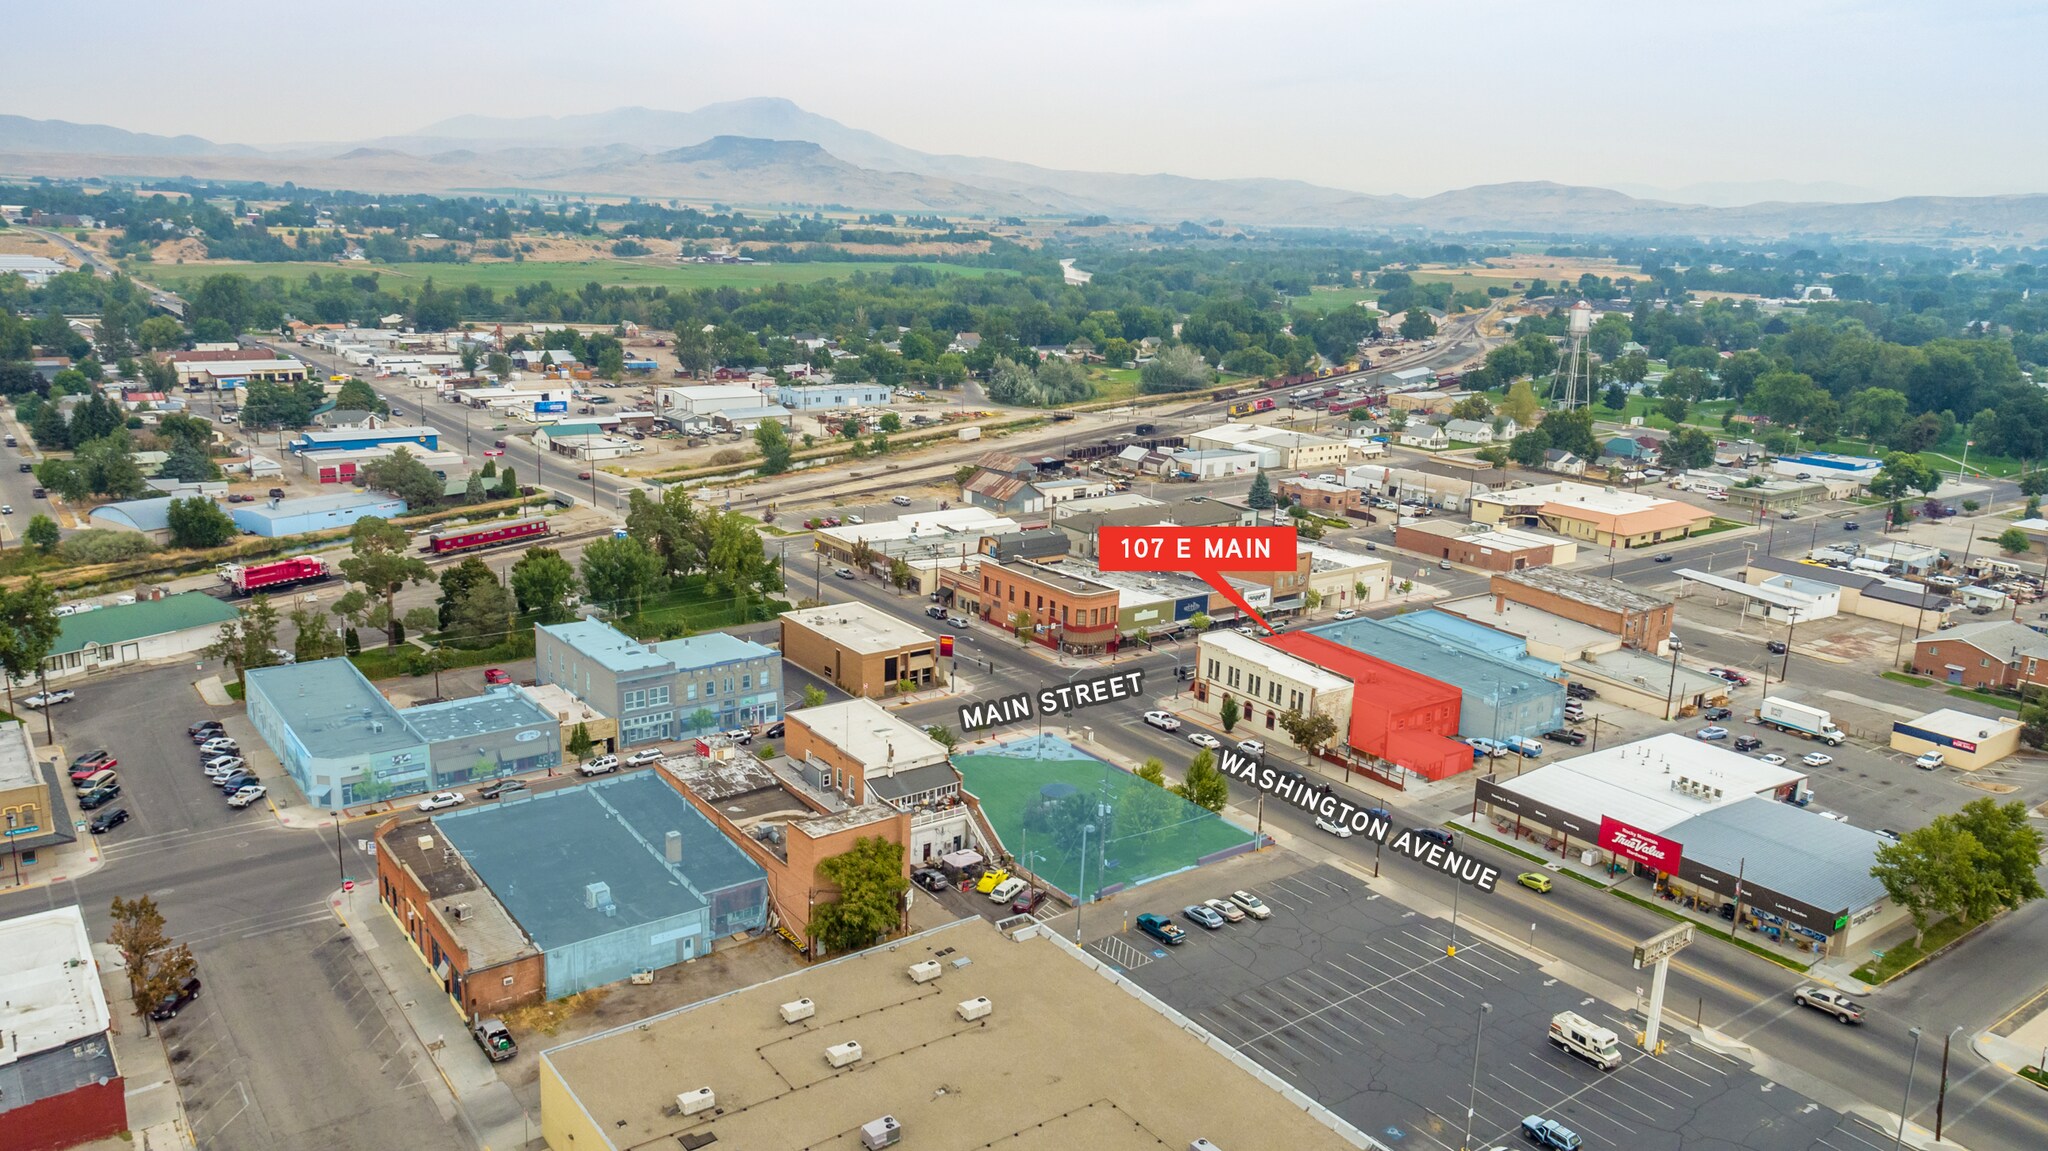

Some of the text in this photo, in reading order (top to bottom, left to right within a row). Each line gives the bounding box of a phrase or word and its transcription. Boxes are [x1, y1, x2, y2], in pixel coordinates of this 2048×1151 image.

[1622, 827, 1659, 846] Rocky Mountain
[1626, 848, 1649, 861] Hardware
